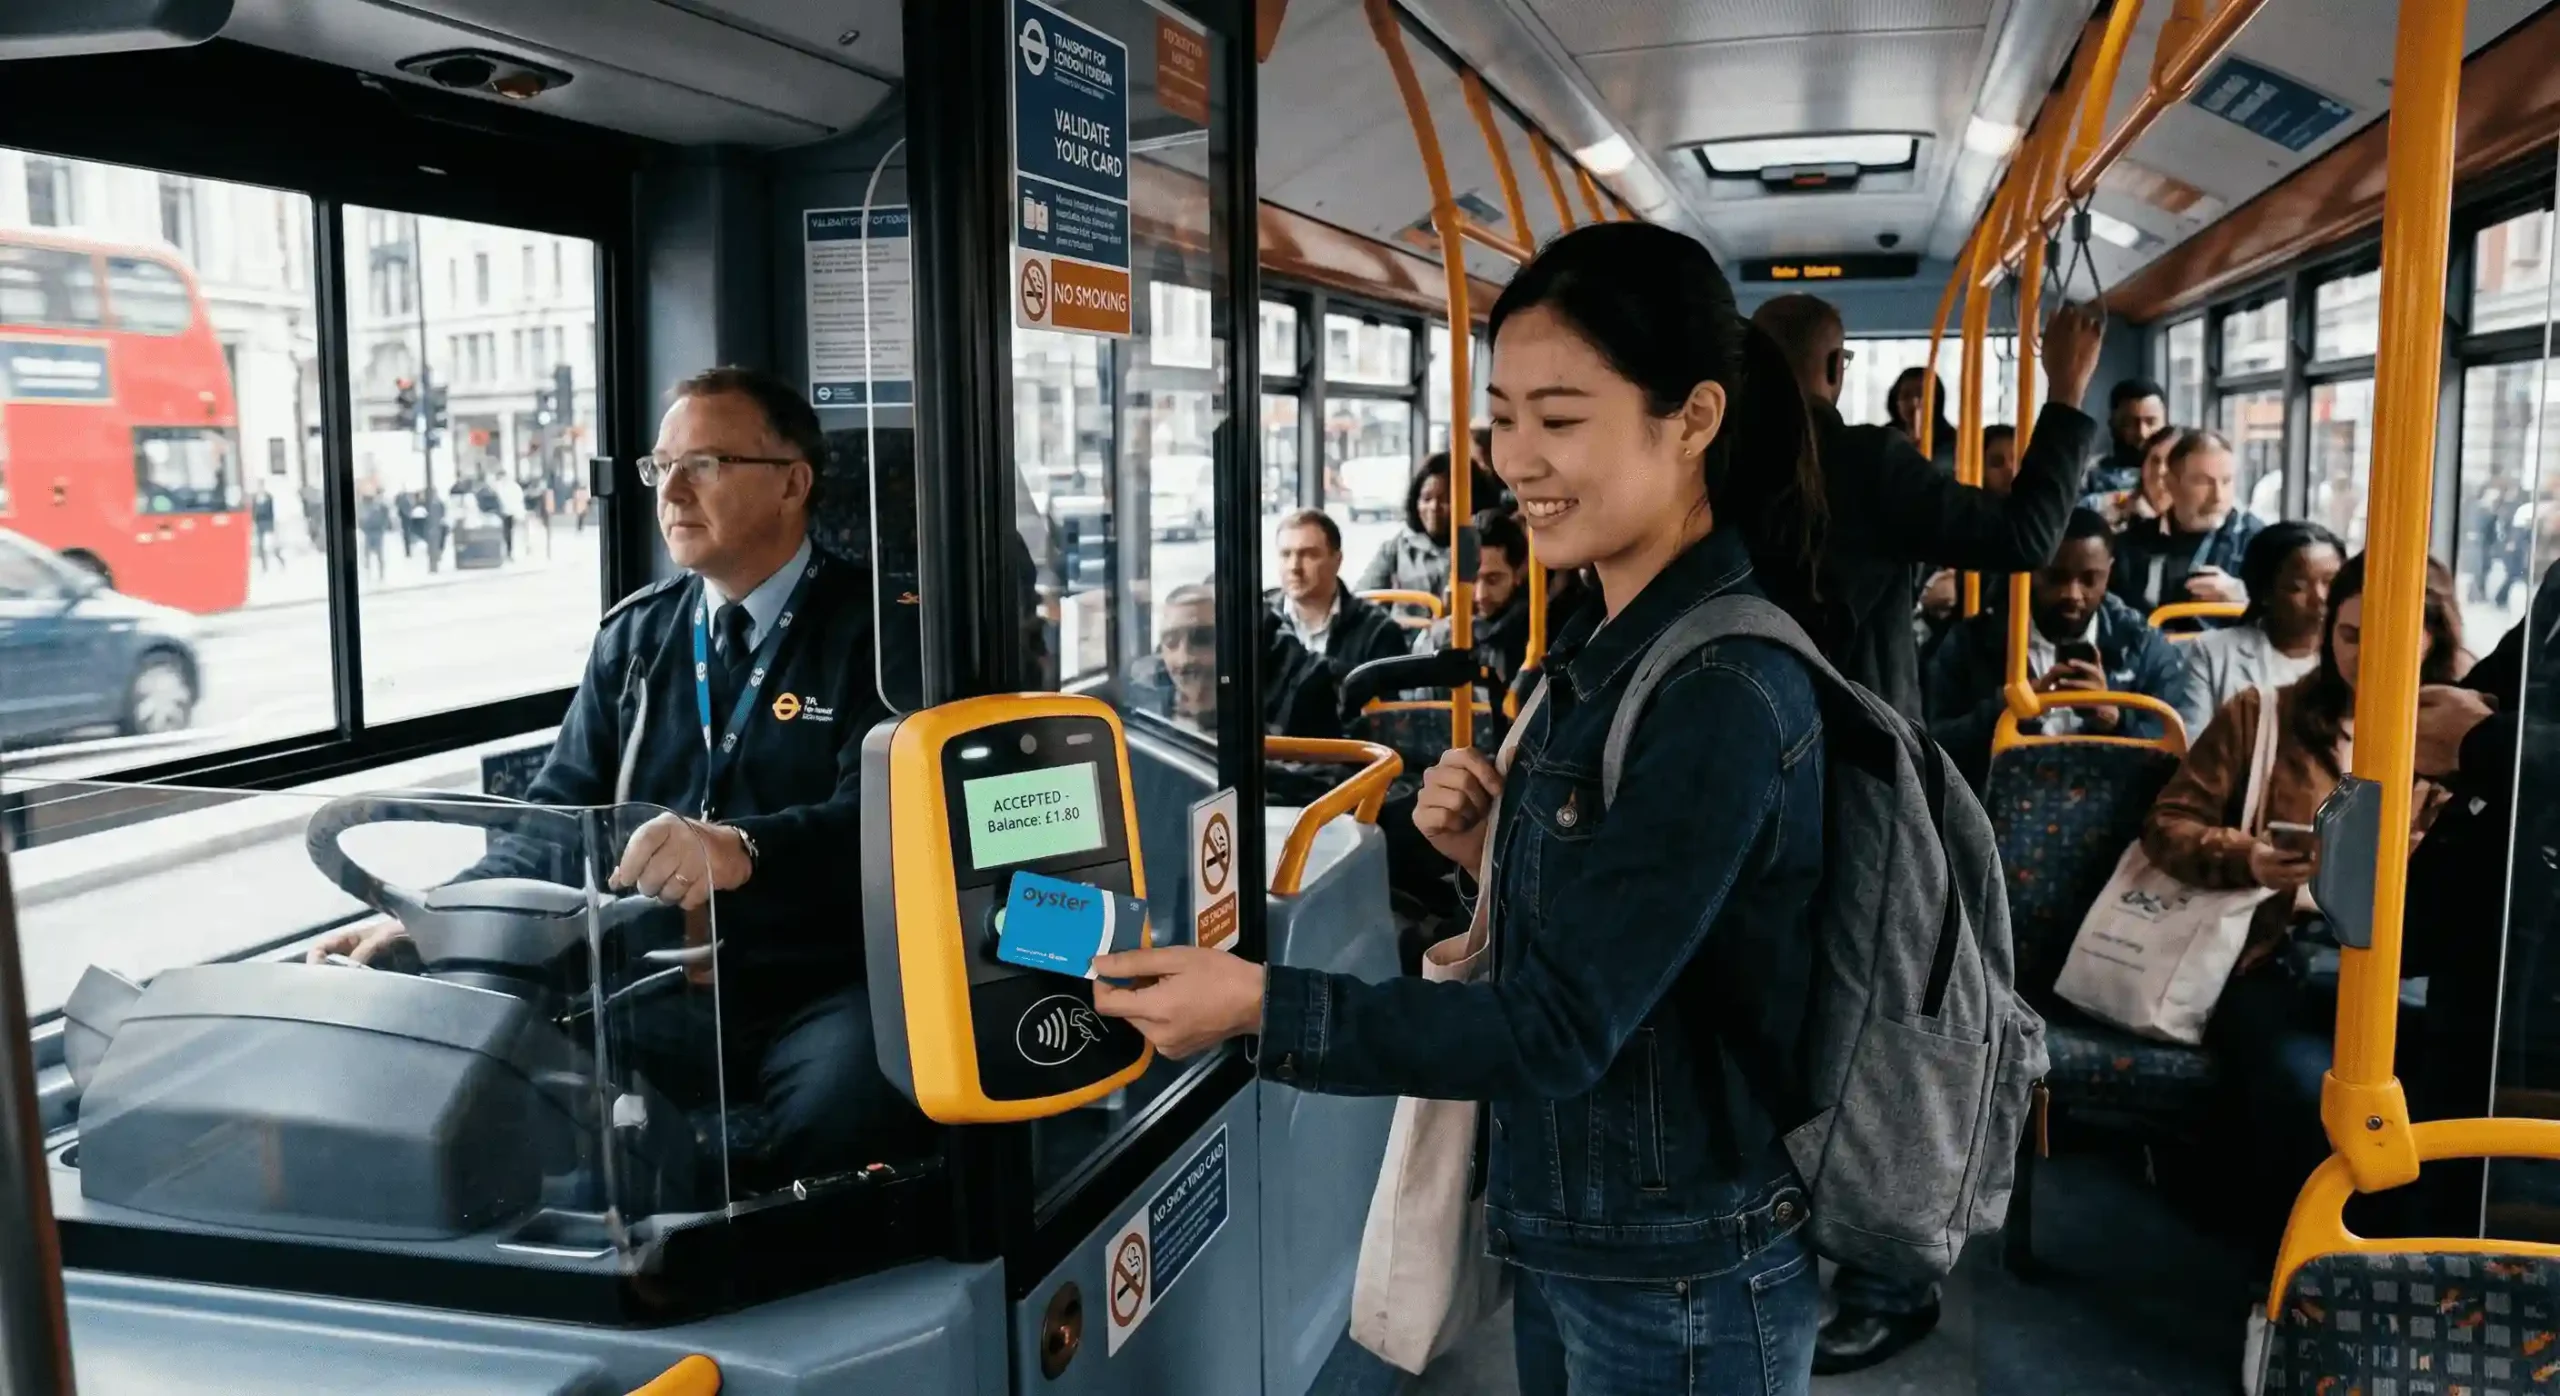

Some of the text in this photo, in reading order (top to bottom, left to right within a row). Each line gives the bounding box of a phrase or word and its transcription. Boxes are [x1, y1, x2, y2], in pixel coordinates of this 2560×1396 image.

[1054, 108, 1110, 148] VALIDATE
[1054, 136, 1122, 178] YOUR CARD
[1054, 282, 1127, 313] NO SMOKING
[993, 790, 1061, 813] ACCEPTED
[988, 806, 1080, 833] Balance: £1.80
